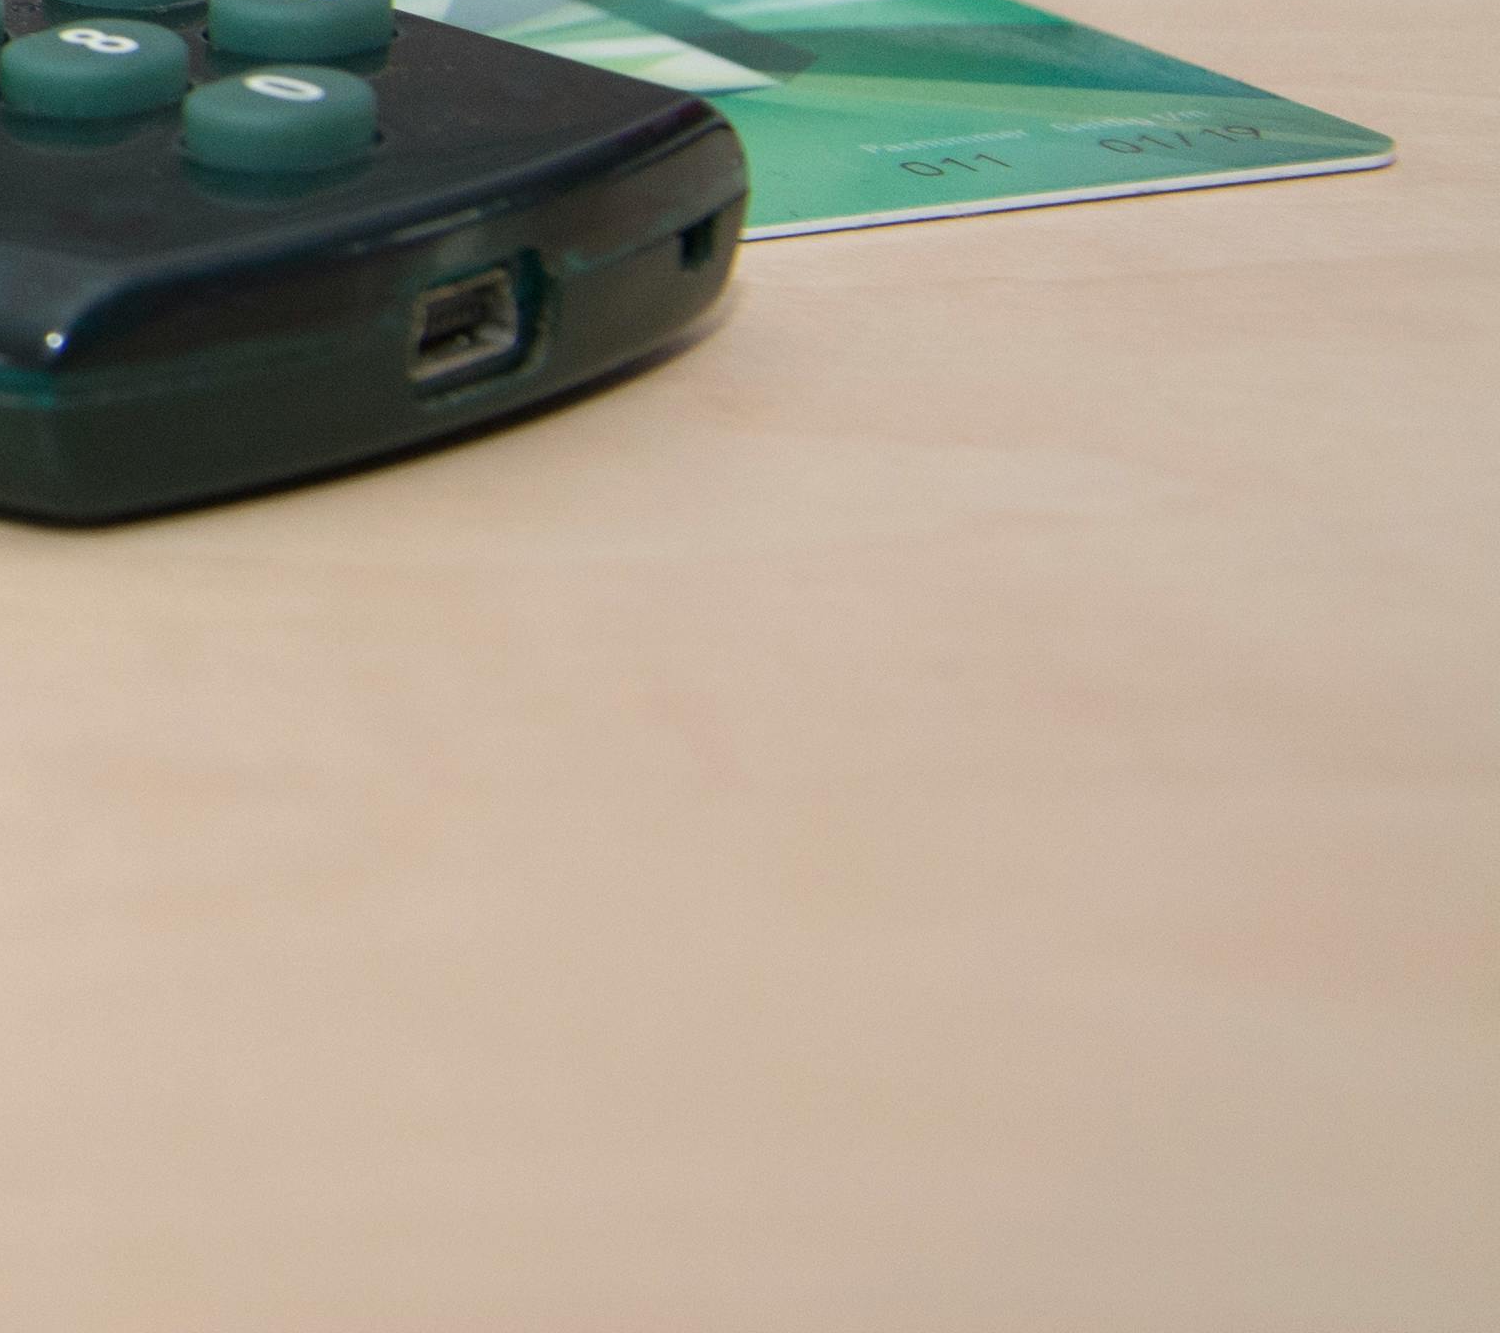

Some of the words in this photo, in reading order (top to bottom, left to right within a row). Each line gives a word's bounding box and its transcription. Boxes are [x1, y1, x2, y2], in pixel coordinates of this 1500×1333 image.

[58, 28, 140, 54] 8
[244, 74, 326, 102] 0
[899, 153, 1013, 176] 011
